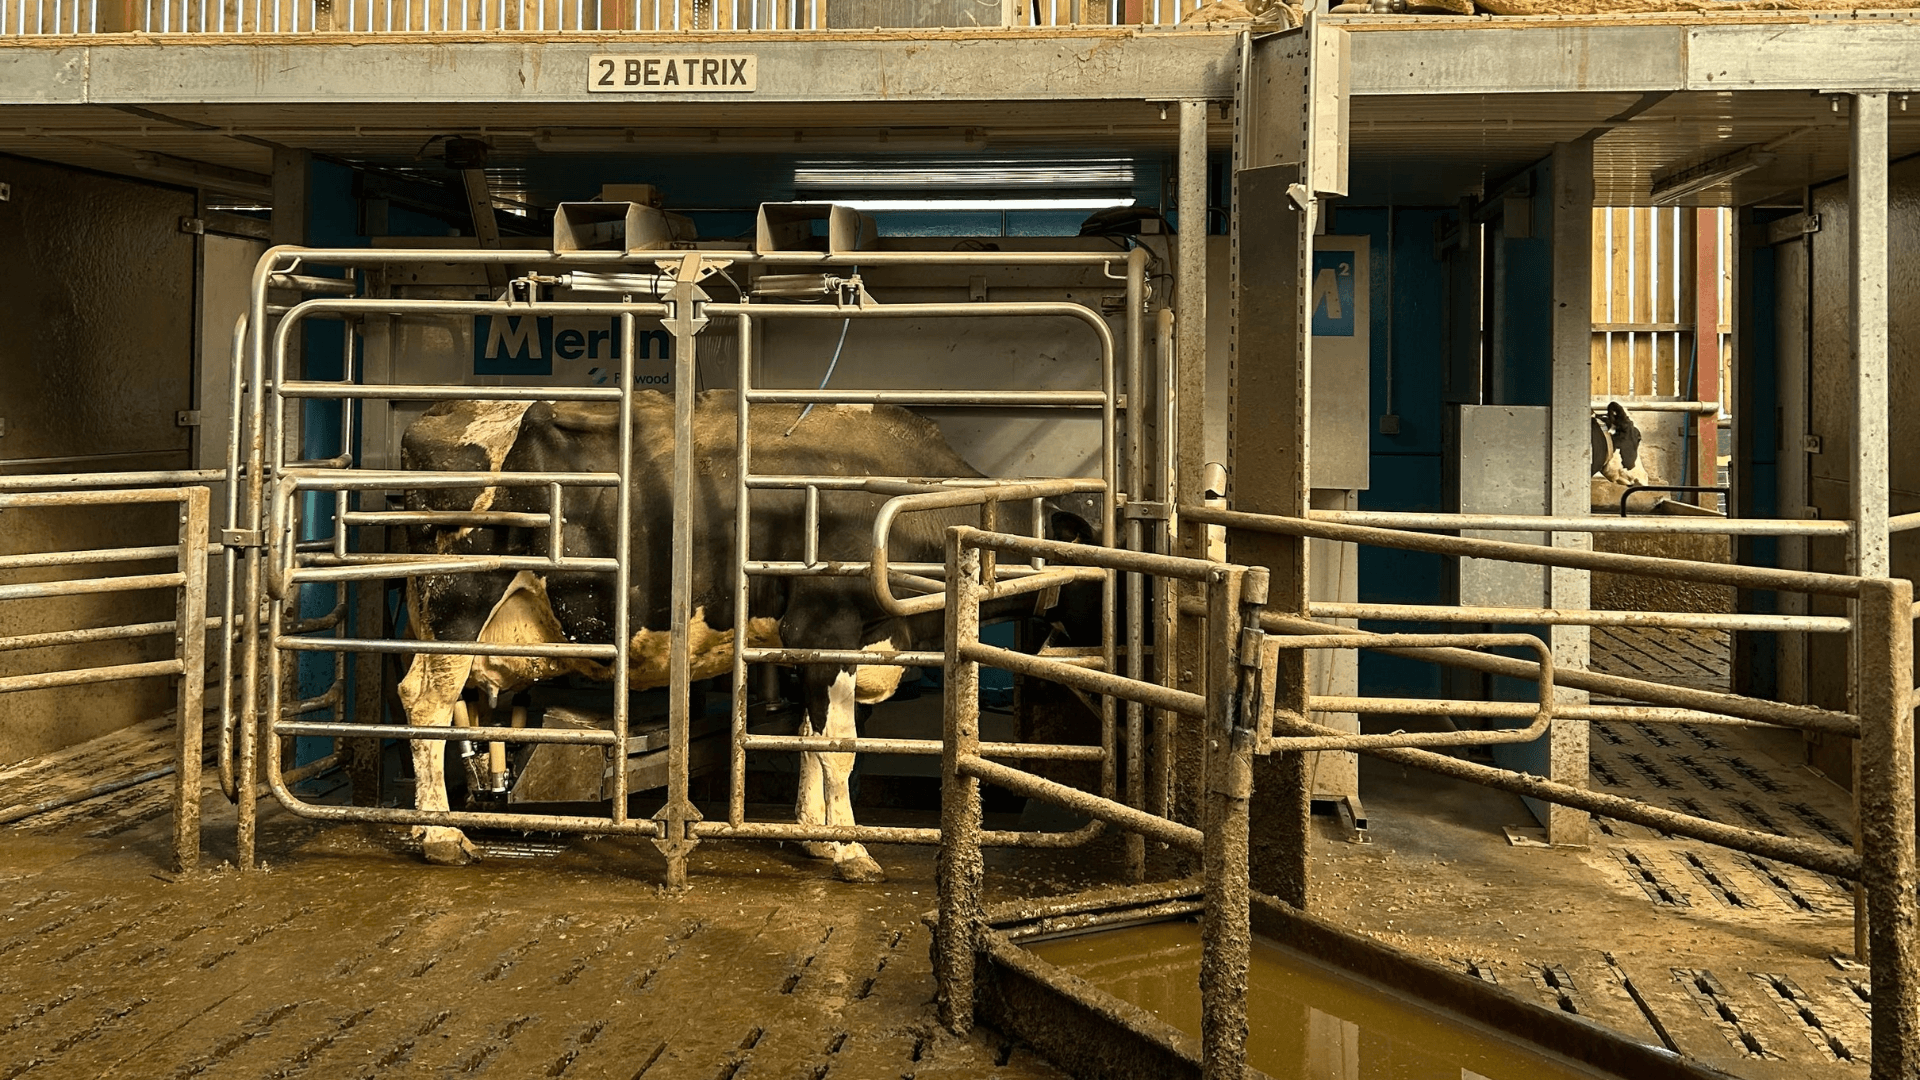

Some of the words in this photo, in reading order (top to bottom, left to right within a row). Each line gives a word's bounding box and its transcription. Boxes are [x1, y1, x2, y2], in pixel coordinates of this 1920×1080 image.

[598, 59, 615, 85] 2
[624, 59, 747, 85] BEATRIX
[484, 314, 670, 360] Merln
[614, 372, 670, 385] Fwood
